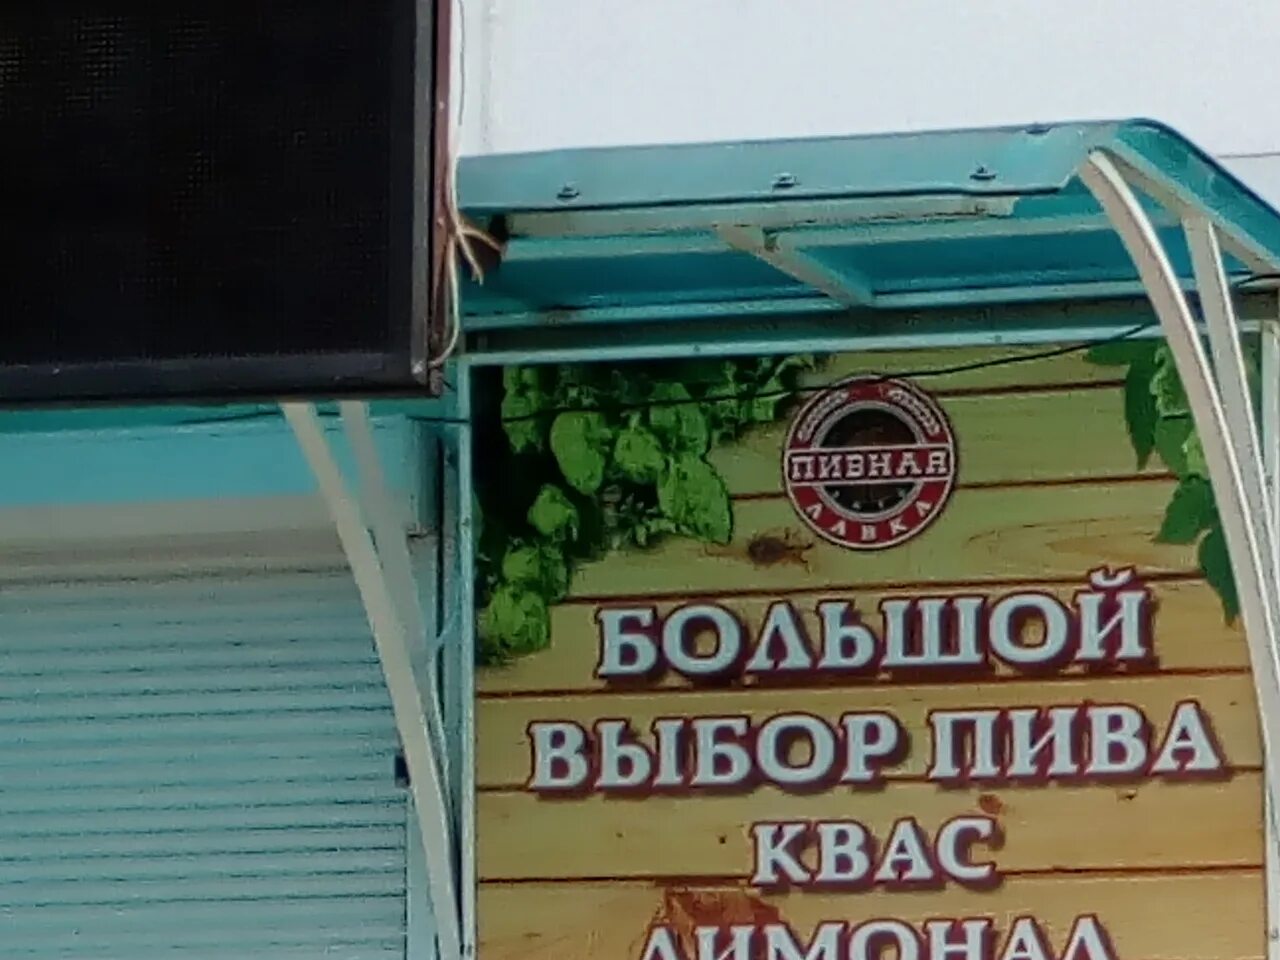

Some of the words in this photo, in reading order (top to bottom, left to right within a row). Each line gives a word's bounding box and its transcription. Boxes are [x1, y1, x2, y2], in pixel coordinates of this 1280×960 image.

[790, 451, 948, 480] ПИВНАЯ
[805, 500, 932, 541] ЛАВКА
[602, 568, 1148, 675] БОЛЬШОЙ
[528, 711, 898, 789] ВЫБОР
[926, 701, 1221, 779] ПИВА
[750, 815, 994, 885] КВАС
